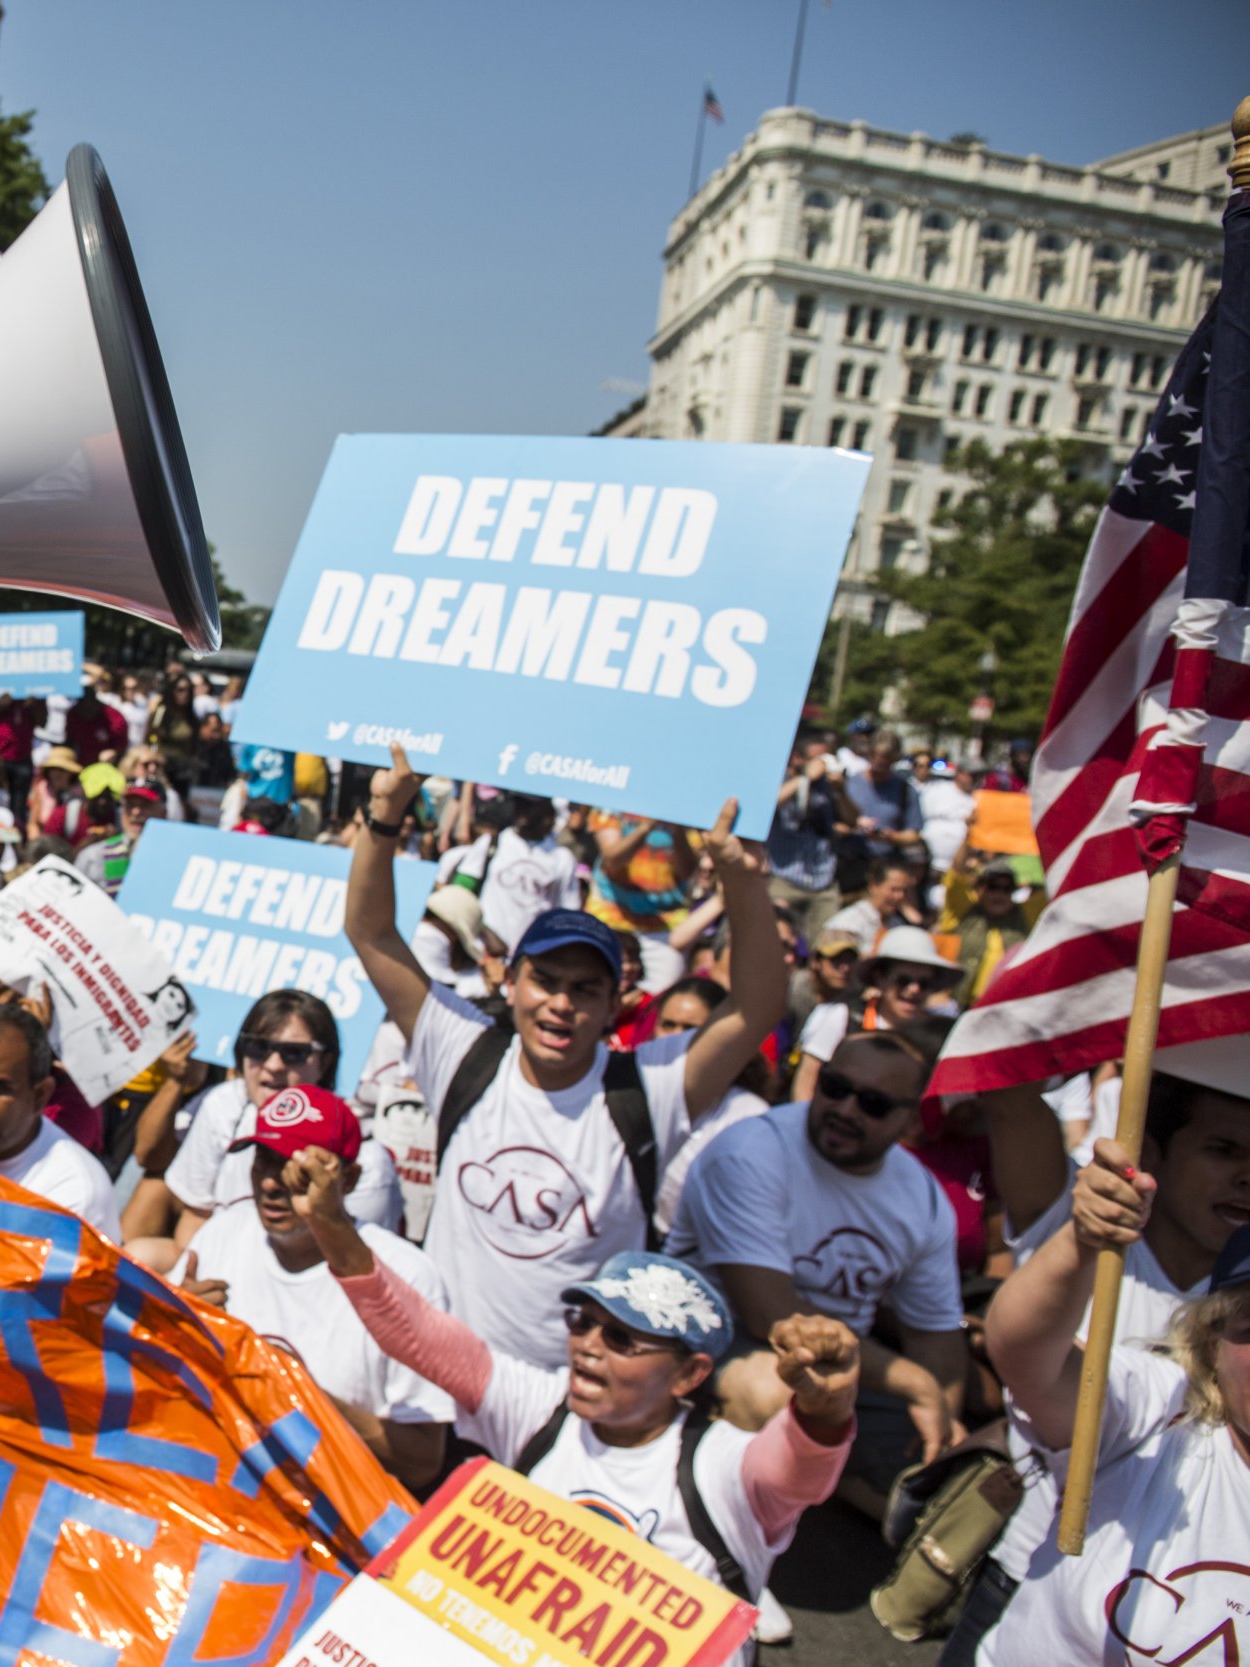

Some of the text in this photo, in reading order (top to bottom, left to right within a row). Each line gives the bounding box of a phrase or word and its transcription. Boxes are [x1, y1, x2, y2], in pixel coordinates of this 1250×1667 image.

[393, 475, 718, 577] DEFEND
[297, 570, 768, 708] DREAMERS
[353, 723, 443, 754] @CASAforAll
[525, 752, 631, 789] @CASAforAll
[17, 910, 52, 941] PARA
[50, 938, 75, 964] LOS
[172, 855, 348, 938] DEFEND
[37, 904, 151, 1029] JUSTICIA Y DIGNIDAD
[406, 1147, 435, 1164] JUS
[458, 1162, 599, 1238] CASA
[429, 1514, 669, 1667] UNAFRAID
[469, 1479, 705, 1631] UNDOCUMENTED
[314, 1630, 377, 1667] JUSTI
[404, 1569, 536, 1665] NO TENEMOS
